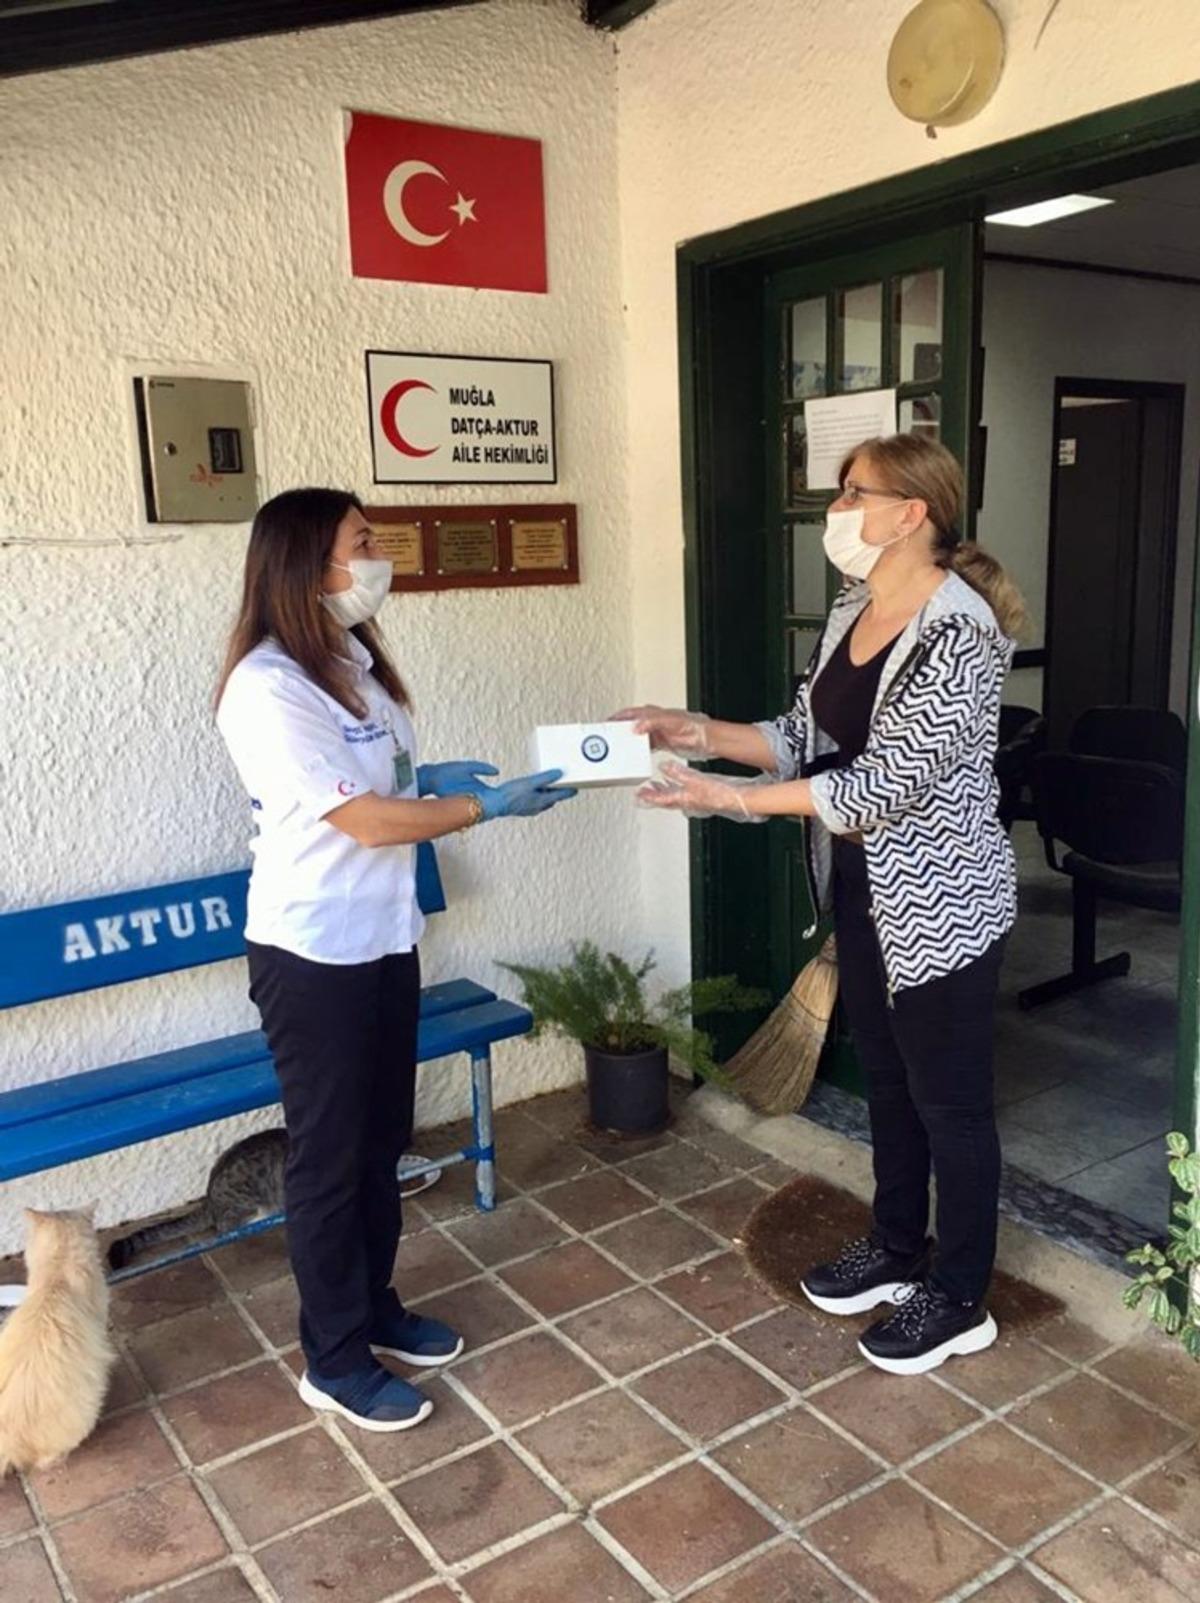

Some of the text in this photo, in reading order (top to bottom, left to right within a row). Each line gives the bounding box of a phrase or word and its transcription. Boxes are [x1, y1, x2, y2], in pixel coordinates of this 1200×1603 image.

[449, 385, 495, 406] MUĞLA
[451, 417, 538, 438] DATÇA-AKTUR
[452, 442, 548, 464] AİLE HEKİMLİĞİ
[63, 897, 232, 962] AKTUR
